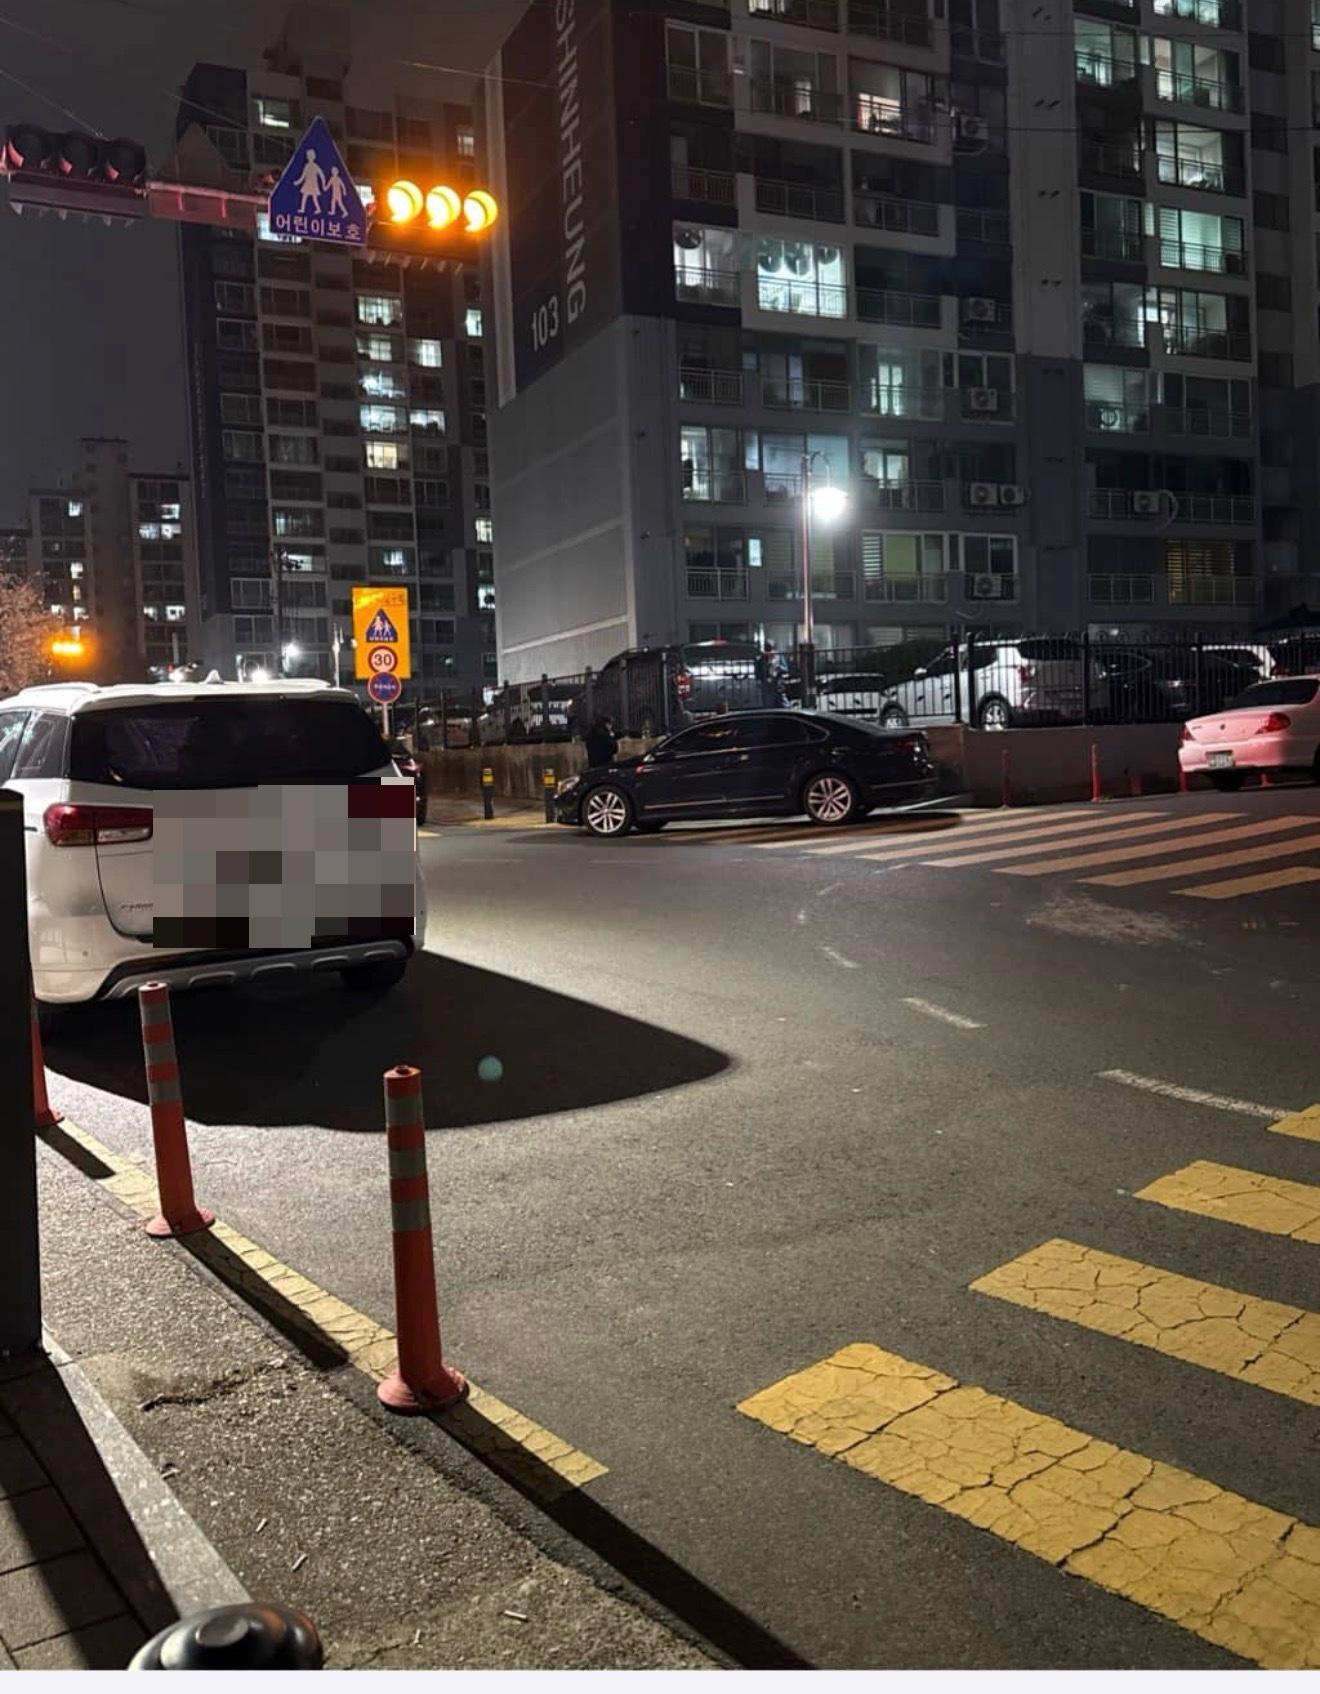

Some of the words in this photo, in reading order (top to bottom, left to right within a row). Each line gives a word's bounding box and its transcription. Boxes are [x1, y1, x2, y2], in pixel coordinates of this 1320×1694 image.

[555, 0, 587, 324] SHINHEUNG
[275, 213, 361, 239] 어린이보호
[531, 295, 559, 352] 103
[373, 653, 393, 666] 30
